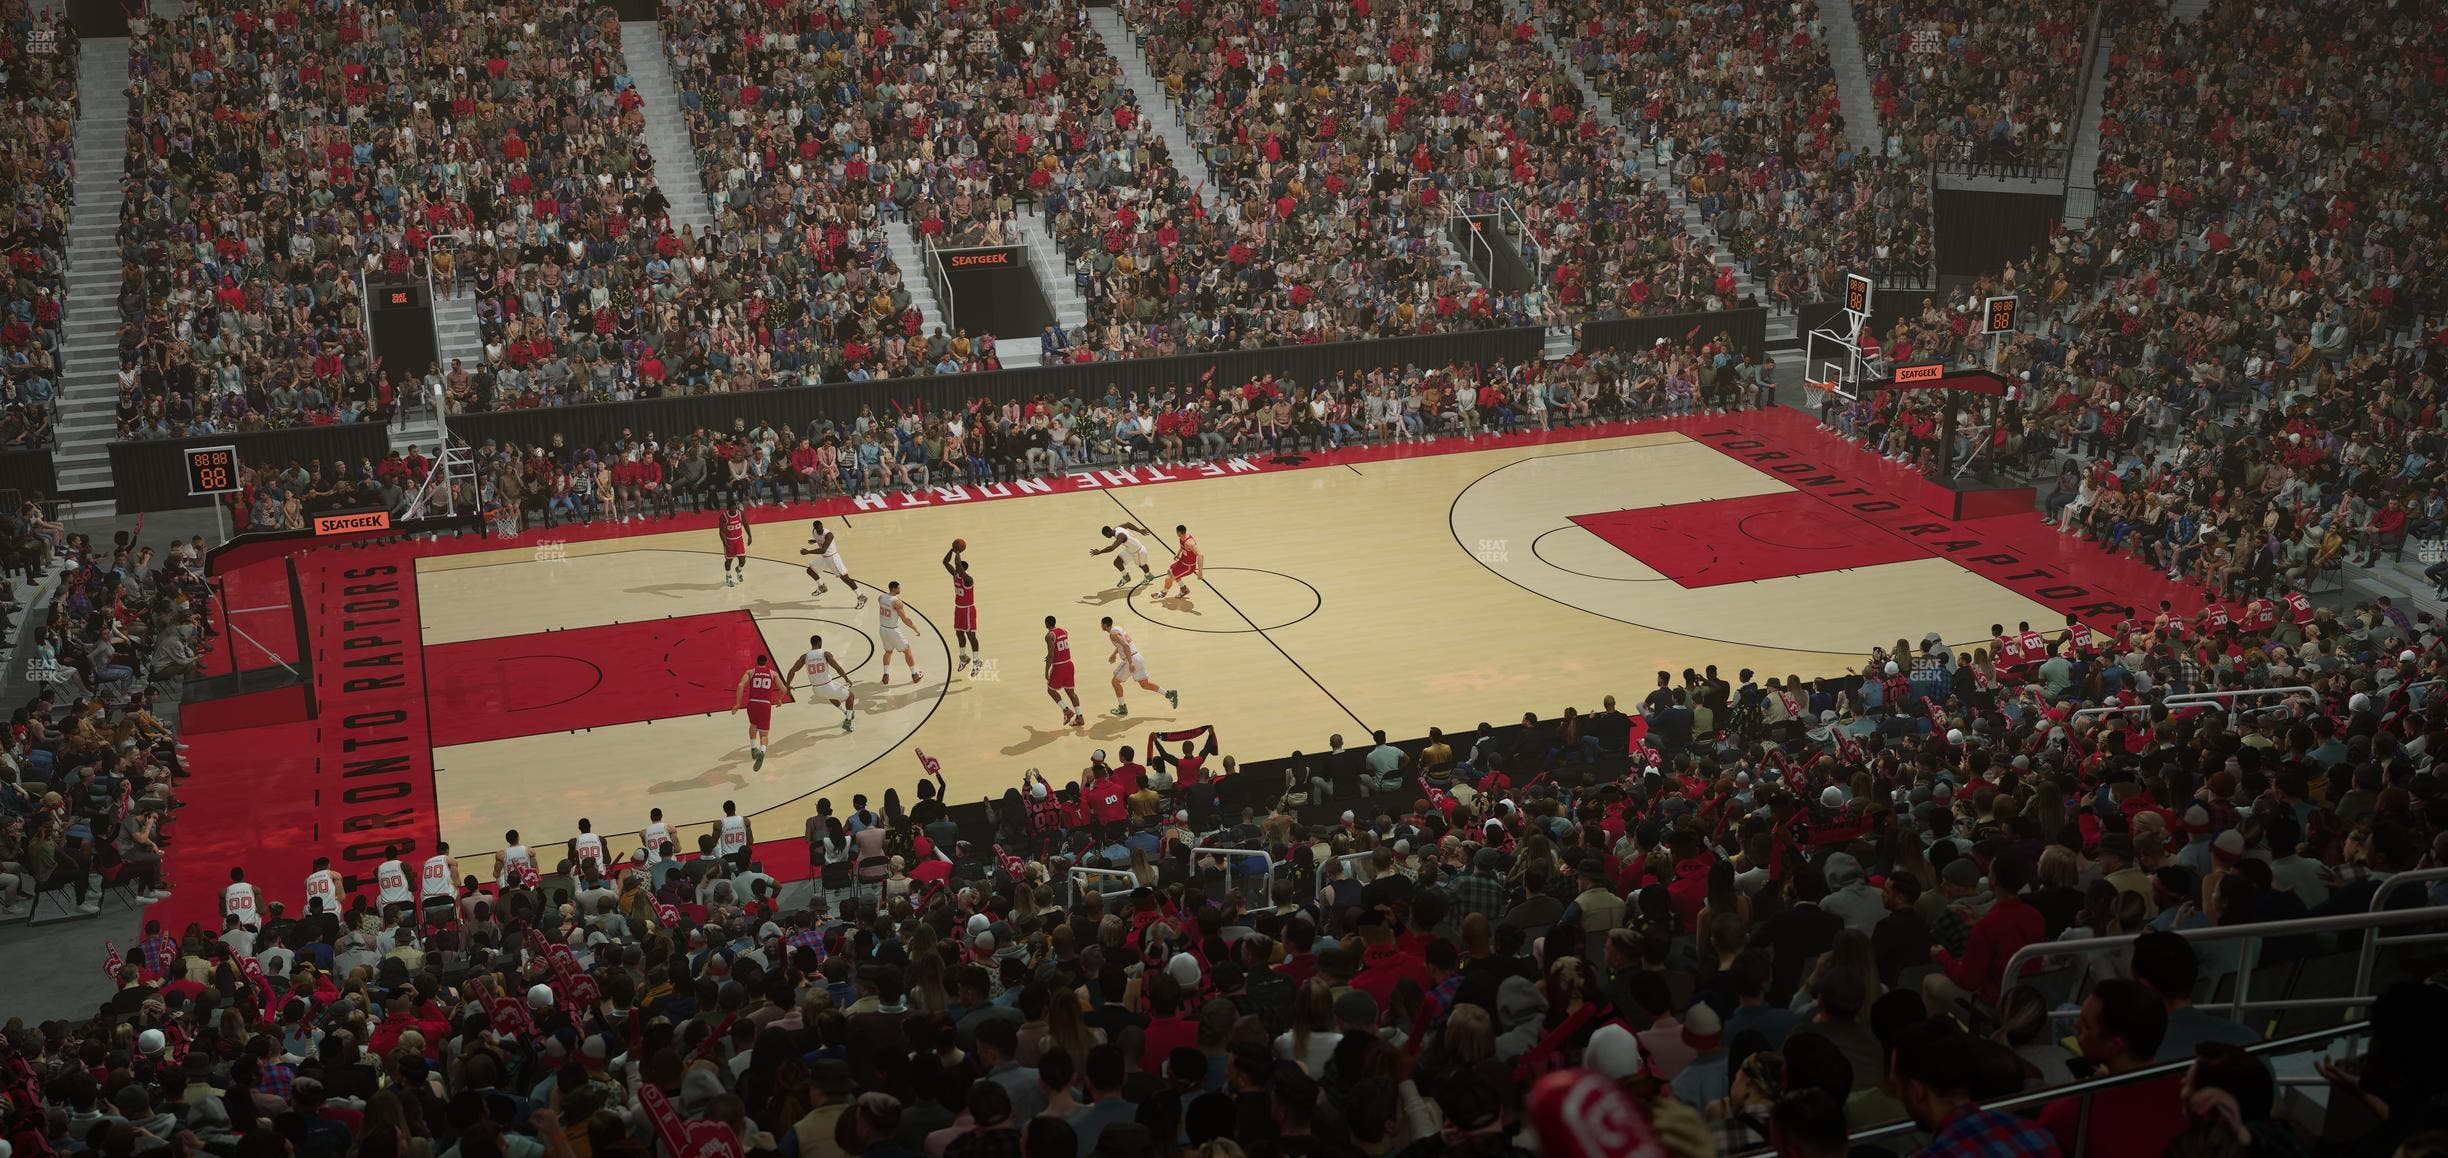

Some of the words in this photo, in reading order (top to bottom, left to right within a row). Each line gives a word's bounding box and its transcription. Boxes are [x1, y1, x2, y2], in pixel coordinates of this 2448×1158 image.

[952, 253, 1008, 267] SEATGEEK
[1850, 291, 1863, 311] 88
[1993, 312, 2010, 330] 88
[1901, 367, 1938, 380] SEATGEEK
[194, 453, 210, 467] 88
[212, 451, 229, 465] 88
[1190, 456, 1261, 479] WE
[1700, 428, 1901, 512] TORONTO
[200, 467, 228, 489] 88
[1070, 464, 1178, 489] THE
[853, 477, 1052, 511] NORTH
[321, 514, 383, 532] SEATGEEK
[343, 564, 406, 692] RAPTORS
[2024, 636, 2044, 650] 00
[807, 662, 826, 676] 00
[751, 677, 772, 690] 00
[343, 708, 417, 894] TORONTO
[1105, 794, 1119, 806] 00
[724, 832, 746, 845] 00
[576, 845, 601, 859] 00
[423, 864, 445, 880] 00
[307, 879, 330, 897] 00
[380, 875, 403, 890] 00
[228, 896, 253, 911] 00
